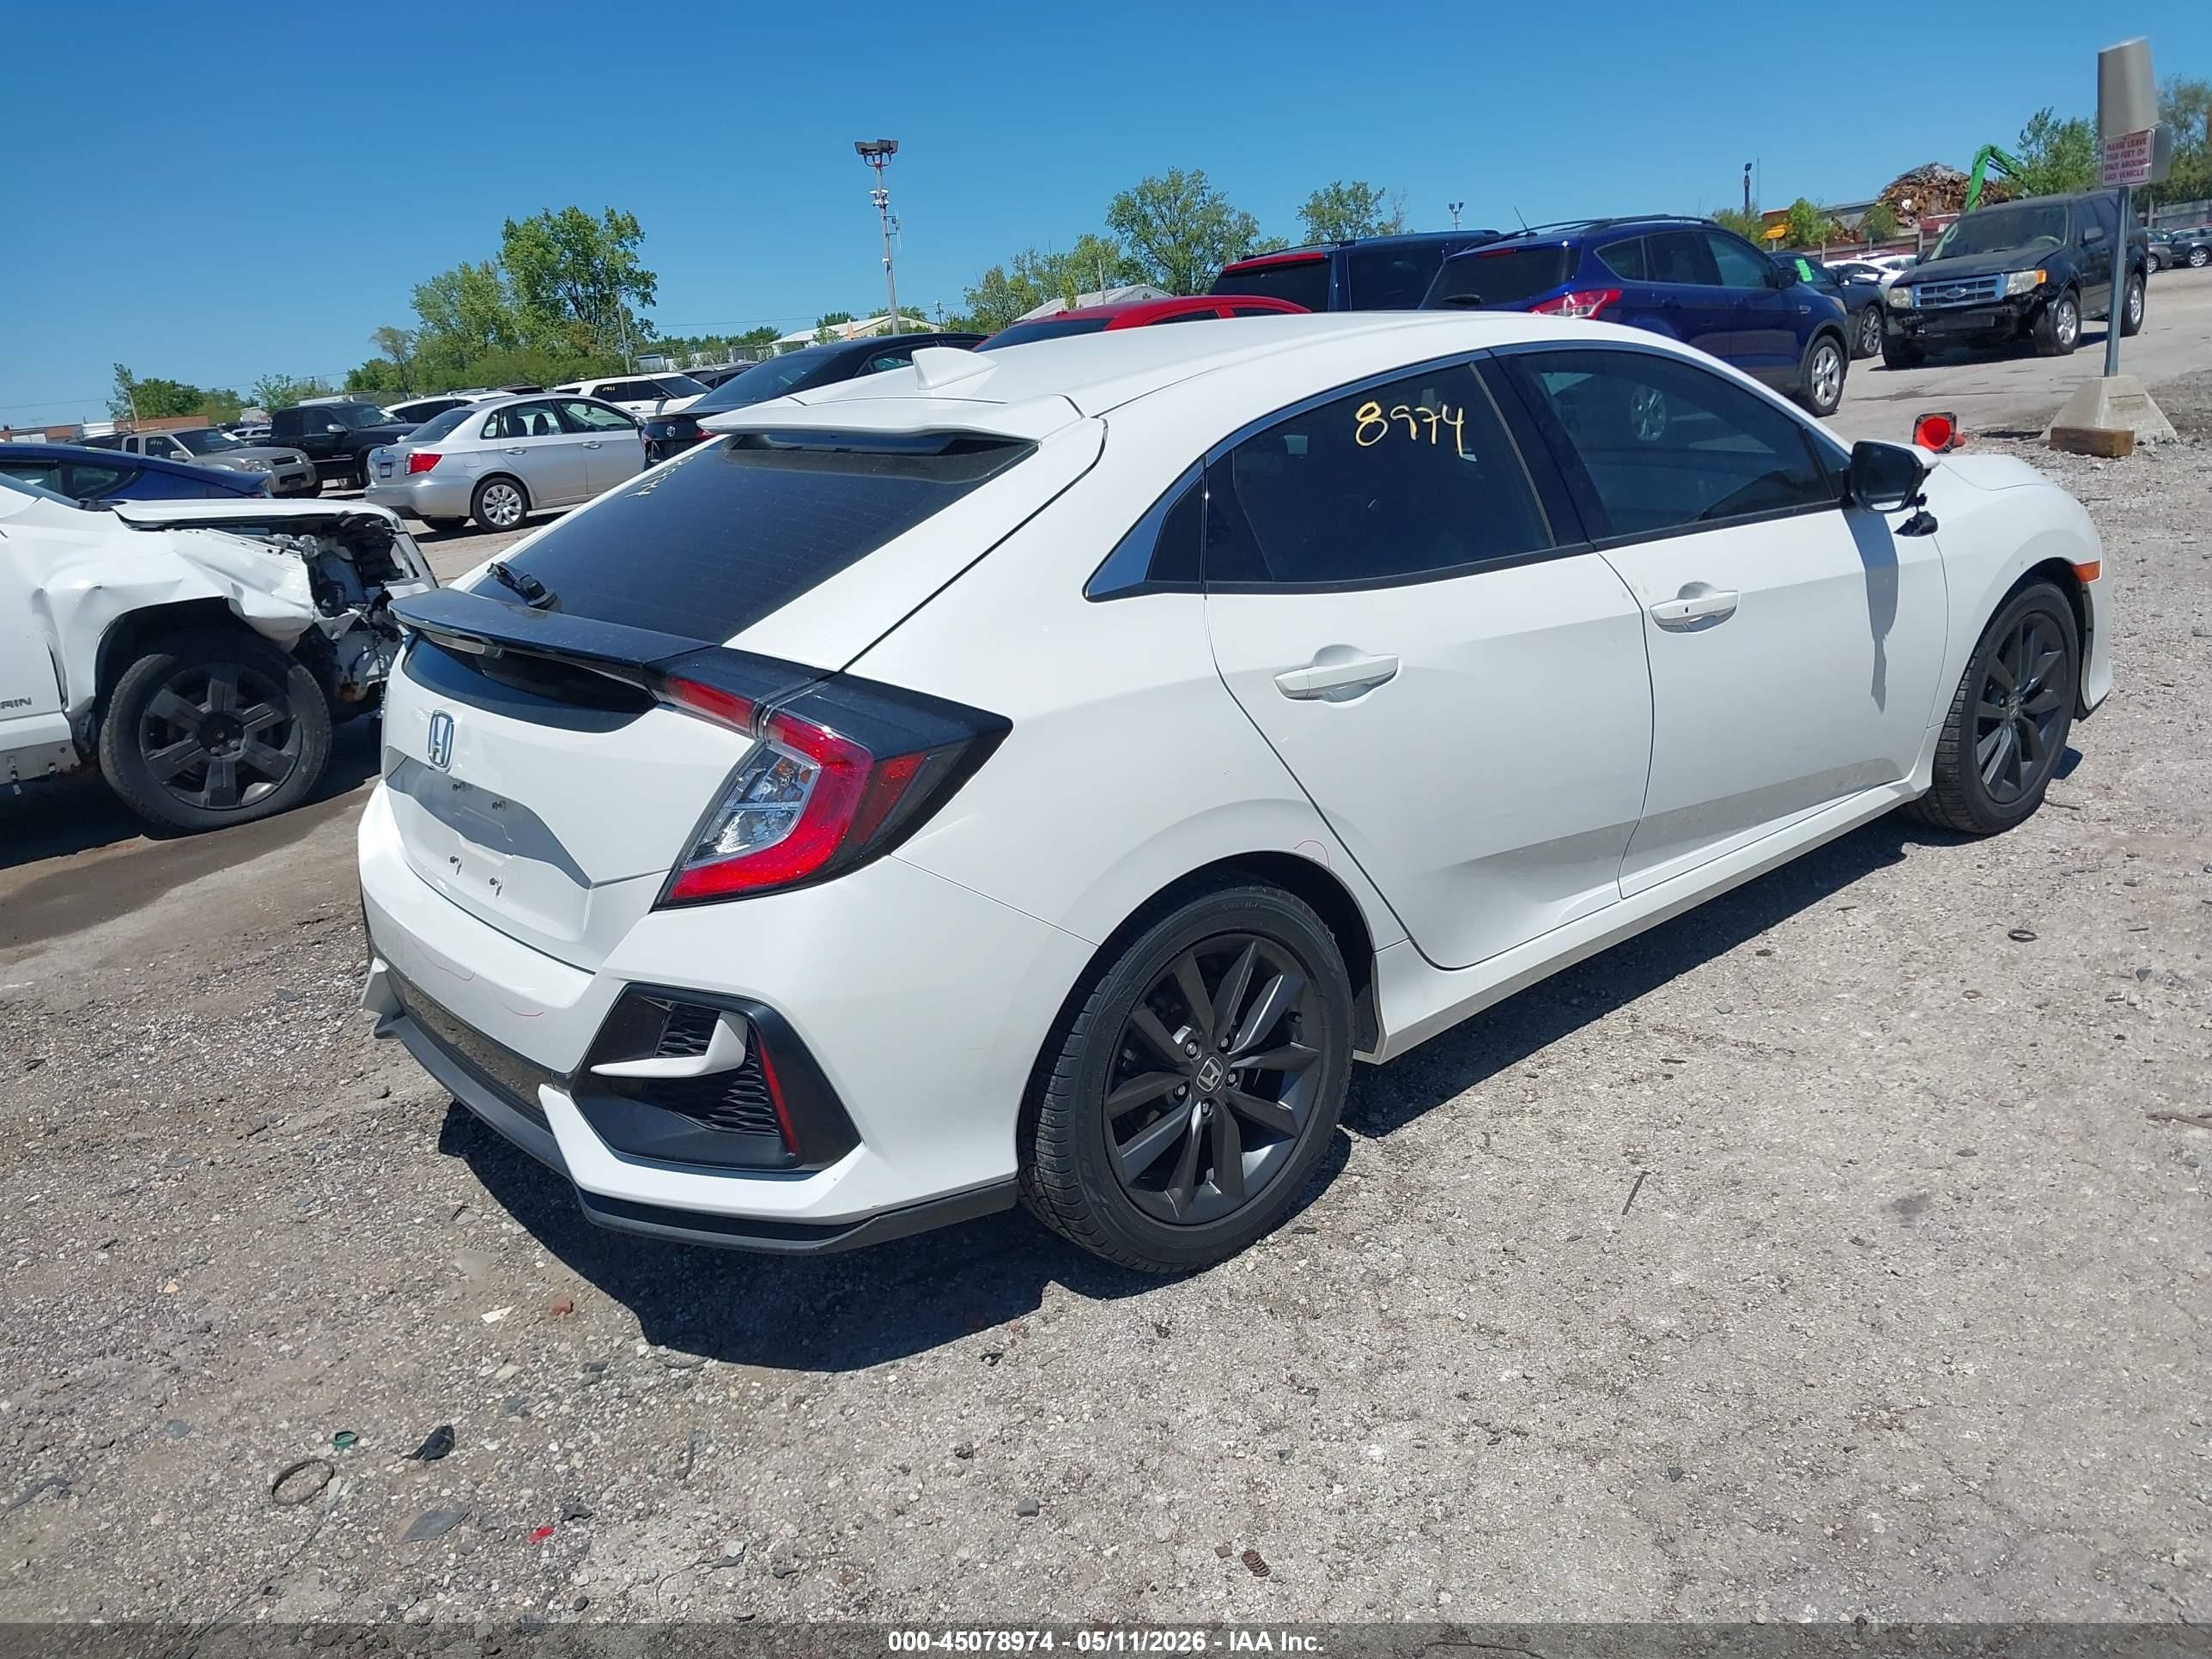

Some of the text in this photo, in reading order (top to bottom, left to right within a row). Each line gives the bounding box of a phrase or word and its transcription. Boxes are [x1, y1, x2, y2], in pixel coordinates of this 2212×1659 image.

[2127, 138, 2146, 147] LEAVE
[2121, 159, 2147, 167] AROUND
[2119, 169, 2143, 179] VEHICLE
[1354, 400, 1466, 459] 8974
